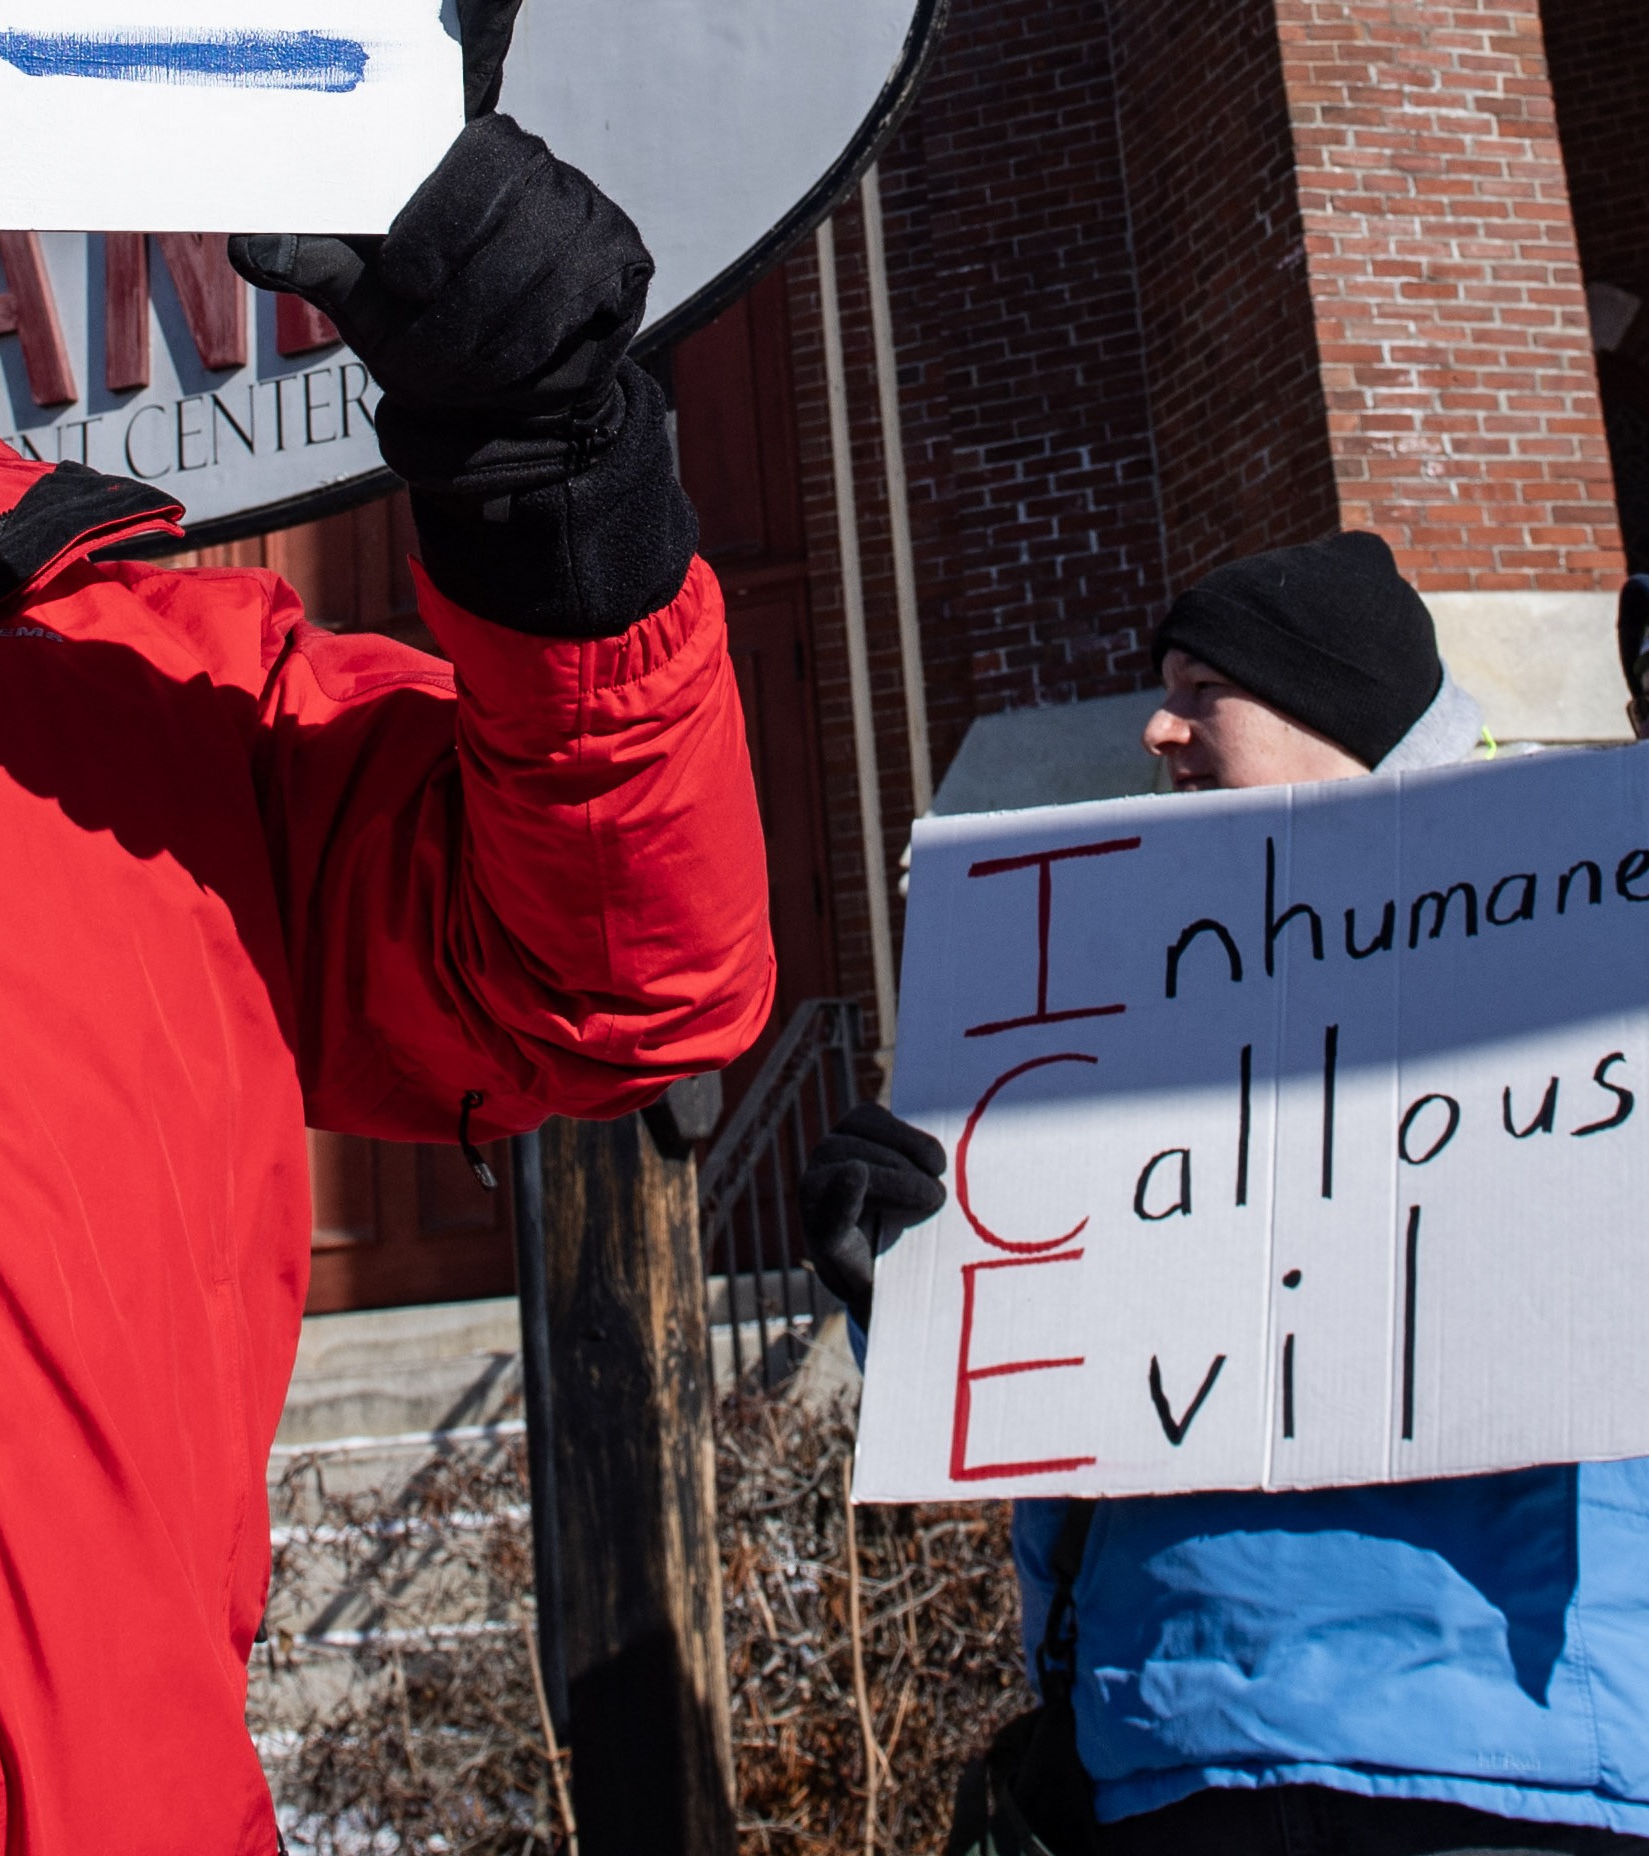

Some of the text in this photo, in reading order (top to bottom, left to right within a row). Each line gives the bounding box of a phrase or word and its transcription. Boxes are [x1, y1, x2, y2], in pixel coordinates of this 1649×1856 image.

[125, 361, 376, 481] CENTER
[956, 1024, 1634, 1255] Callous
[950, 1206, 1421, 1482] Evil
